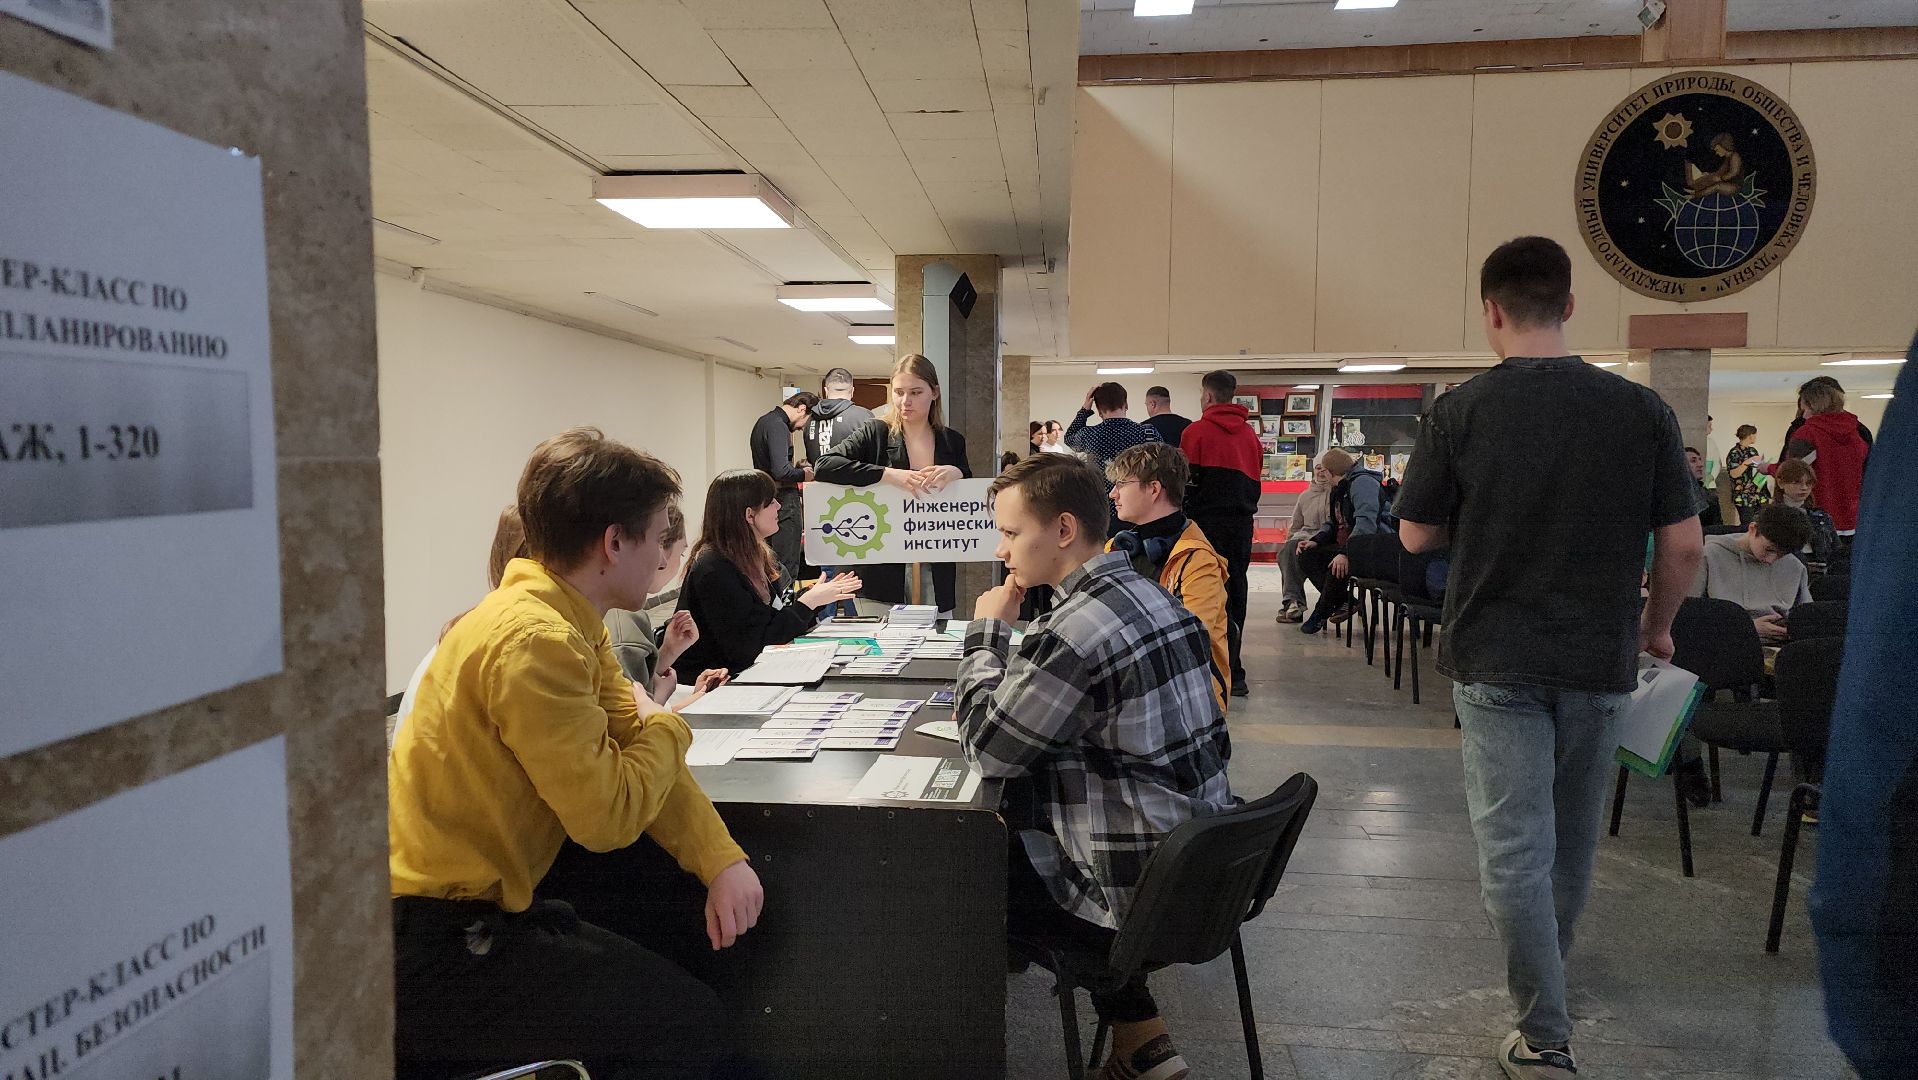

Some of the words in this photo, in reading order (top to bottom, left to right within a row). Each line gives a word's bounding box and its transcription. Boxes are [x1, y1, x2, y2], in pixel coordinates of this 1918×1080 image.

[1742, 86, 1805, 153] ОБЩЕСТВА
[1583, 92, 1650, 191] УНИВЕРСИТЕТ
[1796, 155, 1809, 167] И
[1774, 172, 1811, 248] ЧЕЛОВЕКА
[1580, 198, 1687, 294] МЕЖДУНАРОДНЫЙ
[1716, 253, 1778, 292] "ДУБНА"
[152, 283, 188, 312] ПО
[79, 424, 160, 459] 1-320
[903, 517, 998, 536] физически
[904, 537, 979, 553] институт
[183, 914, 216, 949] ПО
[75, 925, 266, 1058] БЕЗОПАСНОСТИ
